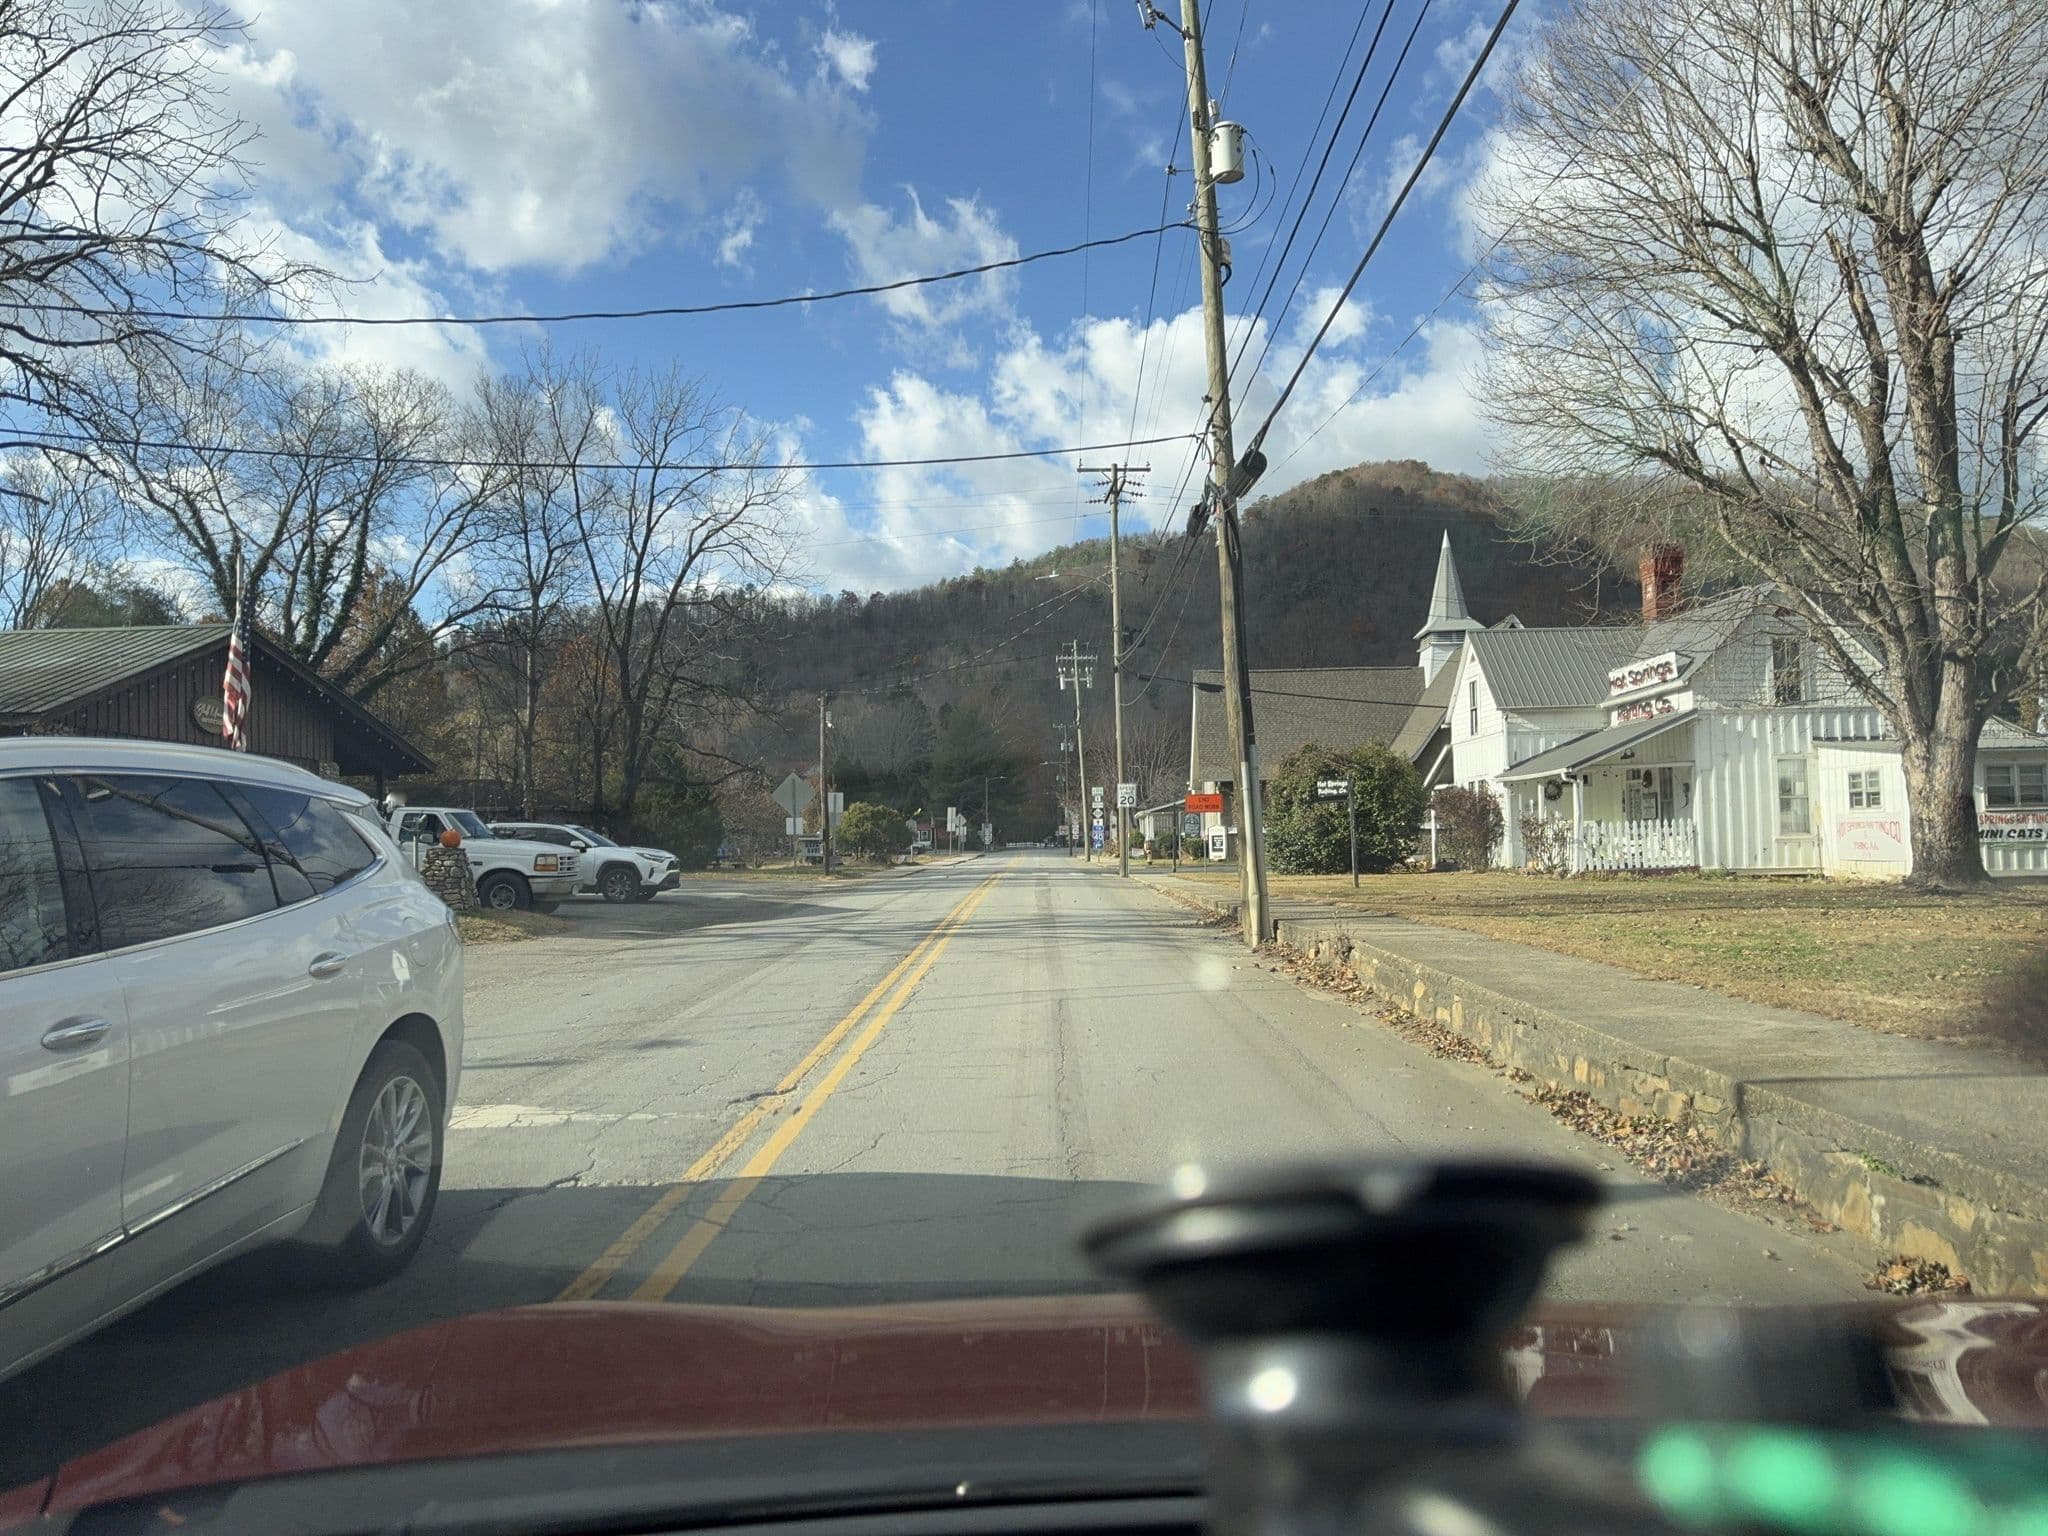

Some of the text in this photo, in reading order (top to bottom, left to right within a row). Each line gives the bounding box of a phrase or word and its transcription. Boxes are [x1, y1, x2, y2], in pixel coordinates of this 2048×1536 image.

[1120, 795, 1135, 805] 20
[1979, 814, 2016, 824] SPRINGS
[2007, 828, 2043, 838] CATS
